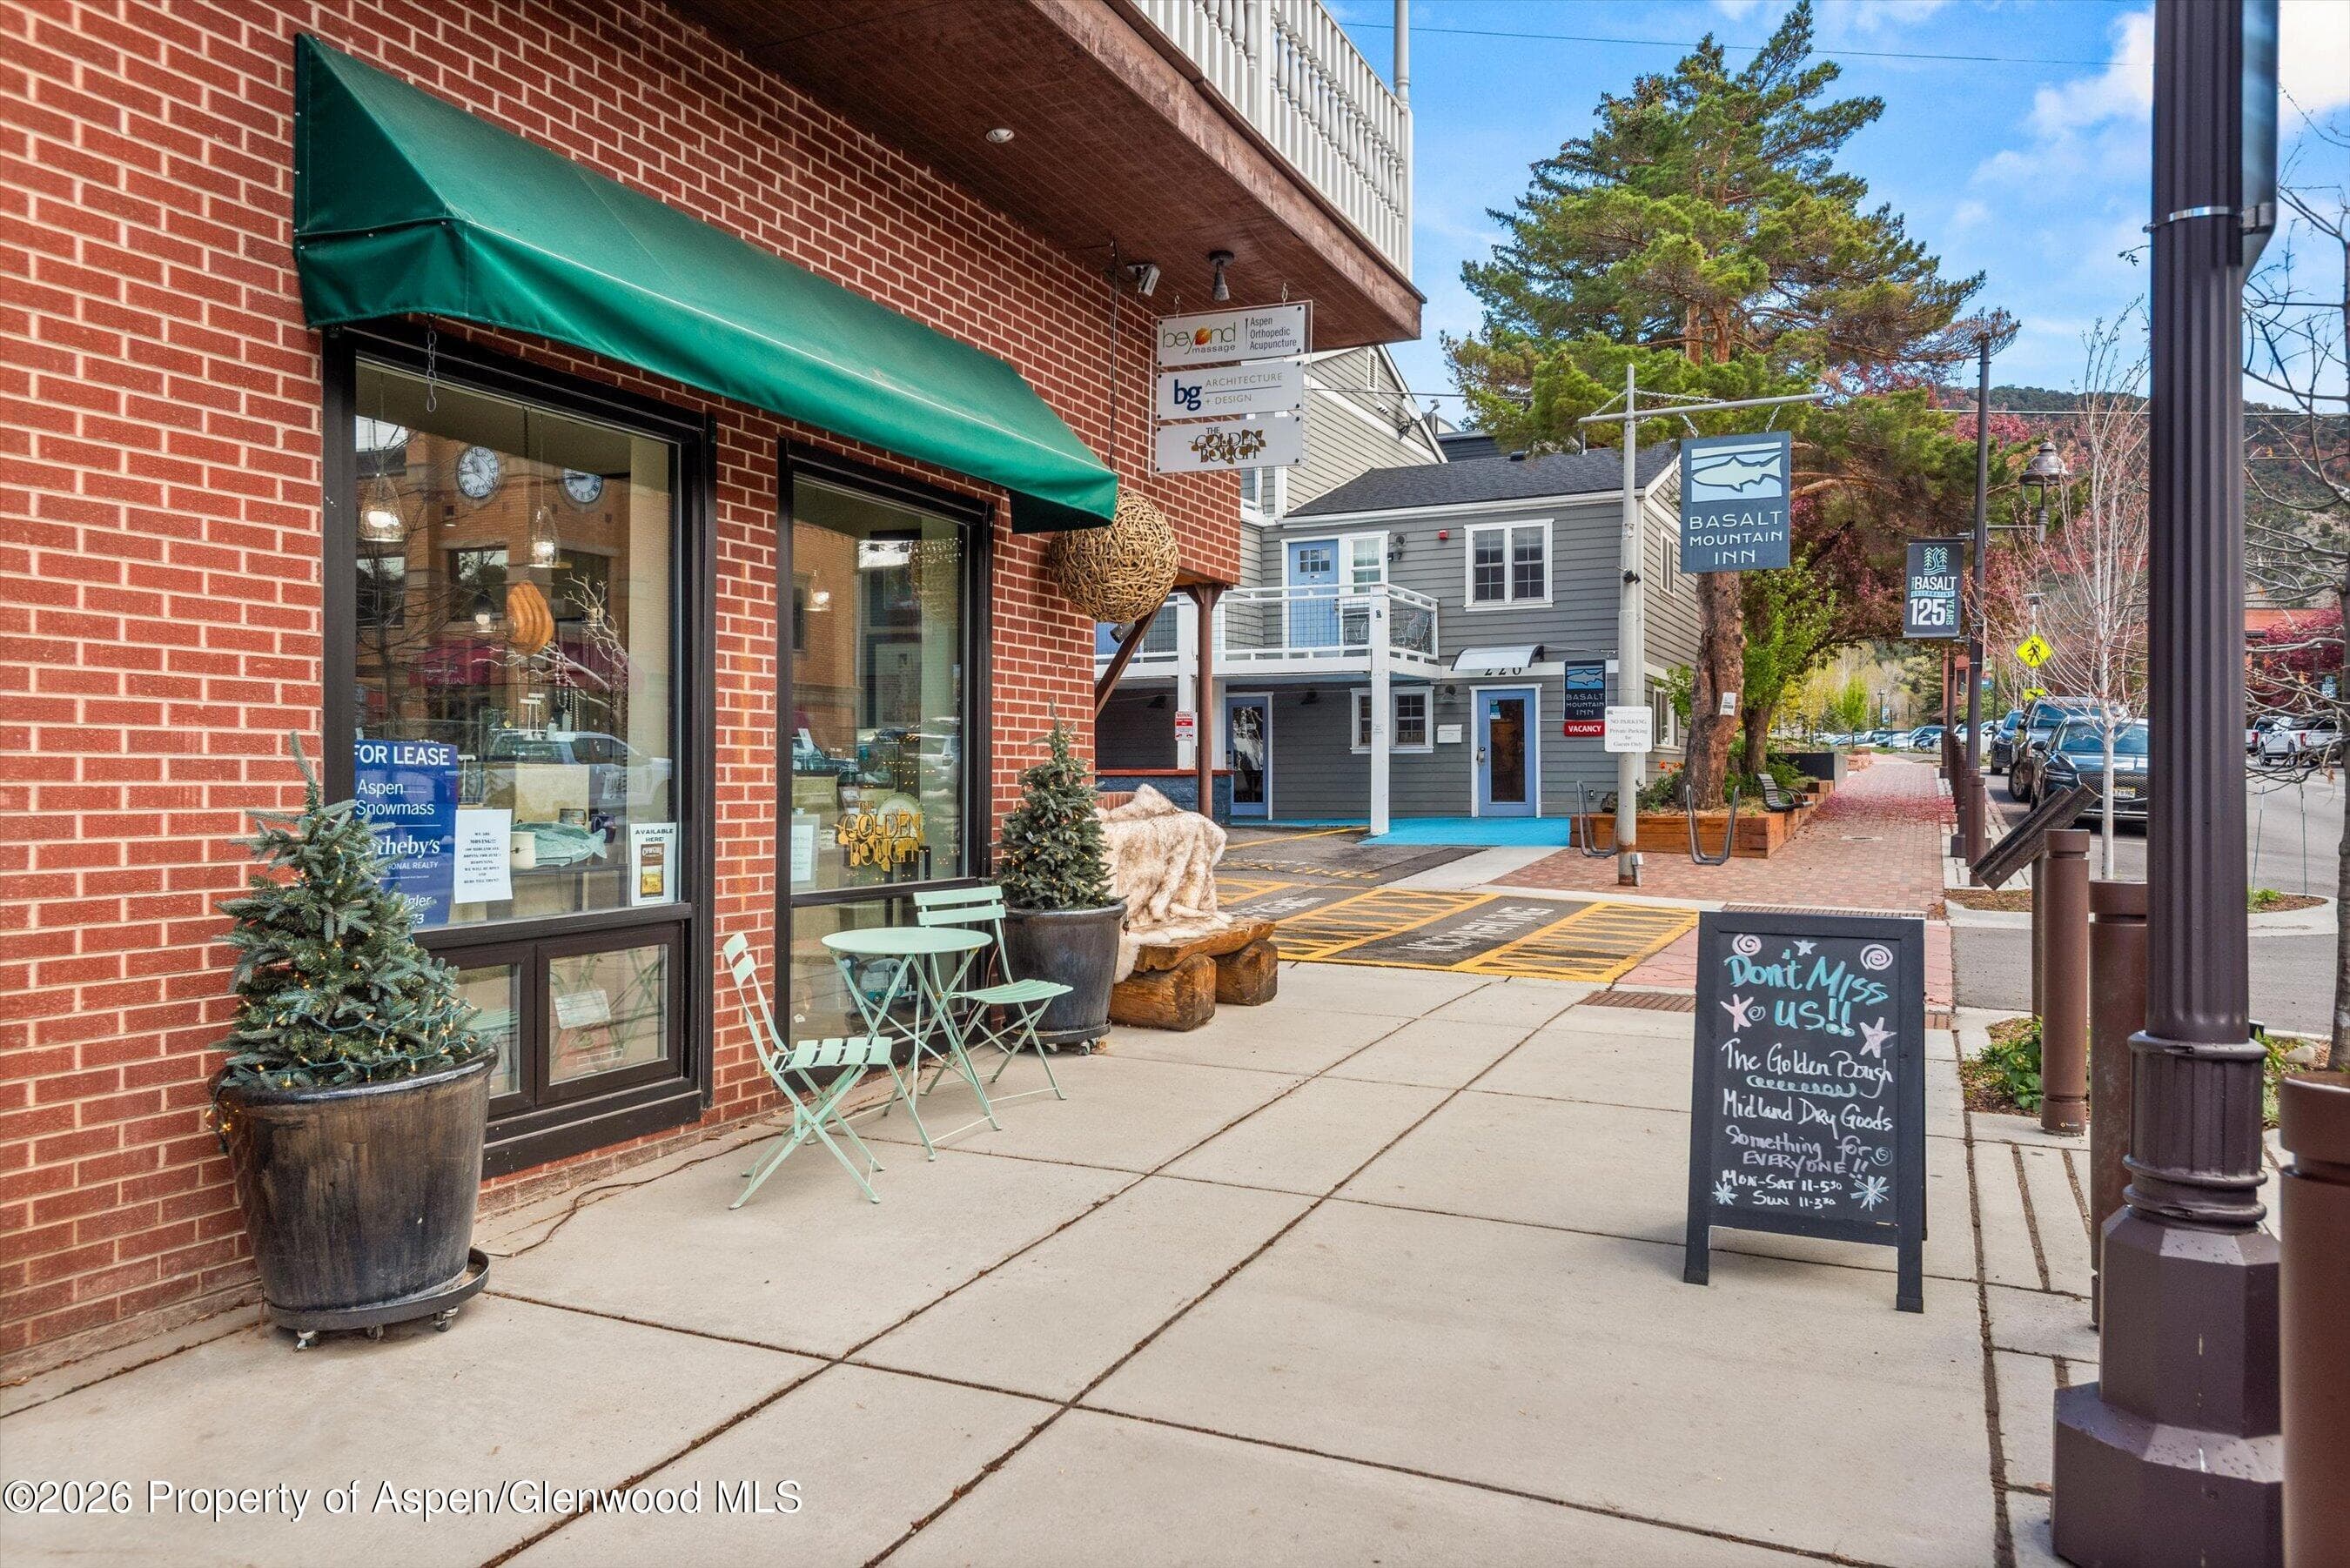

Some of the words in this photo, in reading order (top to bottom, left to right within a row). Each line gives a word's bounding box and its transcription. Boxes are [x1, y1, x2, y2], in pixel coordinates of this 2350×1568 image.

[1250, 317, 1273, 326] Aspen
[1250, 327, 1291, 338] Orthopedic
[1192, 345, 1236, 354] massage
[1249, 338, 1297, 350] Acupuncture
[1205, 372, 1282, 387] ARCHITECTURE
[1174, 379, 1202, 411] bg
[1215, 394, 1252, 405] DESIGN
[1689, 511, 1783, 530] BASALT
[1689, 531, 1783, 547] MOUNTAIN
[1715, 549, 1756, 565] INN
[1915, 576, 1957, 590] BASALT
[1910, 598, 1946, 625] 125
[1946, 599, 1954, 625] YEARS
[394, 746, 450, 766] LEASE
[357, 779, 403, 798] Aspen
[356, 799, 435, 816] Snowmass
[1724, 949, 1803, 990] Don't
[1721, 1038, 1762, 1071] The
[1767, 1042, 1832, 1075] Golden
[1829, 1050, 1894, 1099] Bough
[1723, 1088, 1793, 1121] Midland
[1840, 1103, 1894, 1131] Goods
[1726, 1125, 1822, 1162] Something
[1836, 1135, 1872, 1164] for
